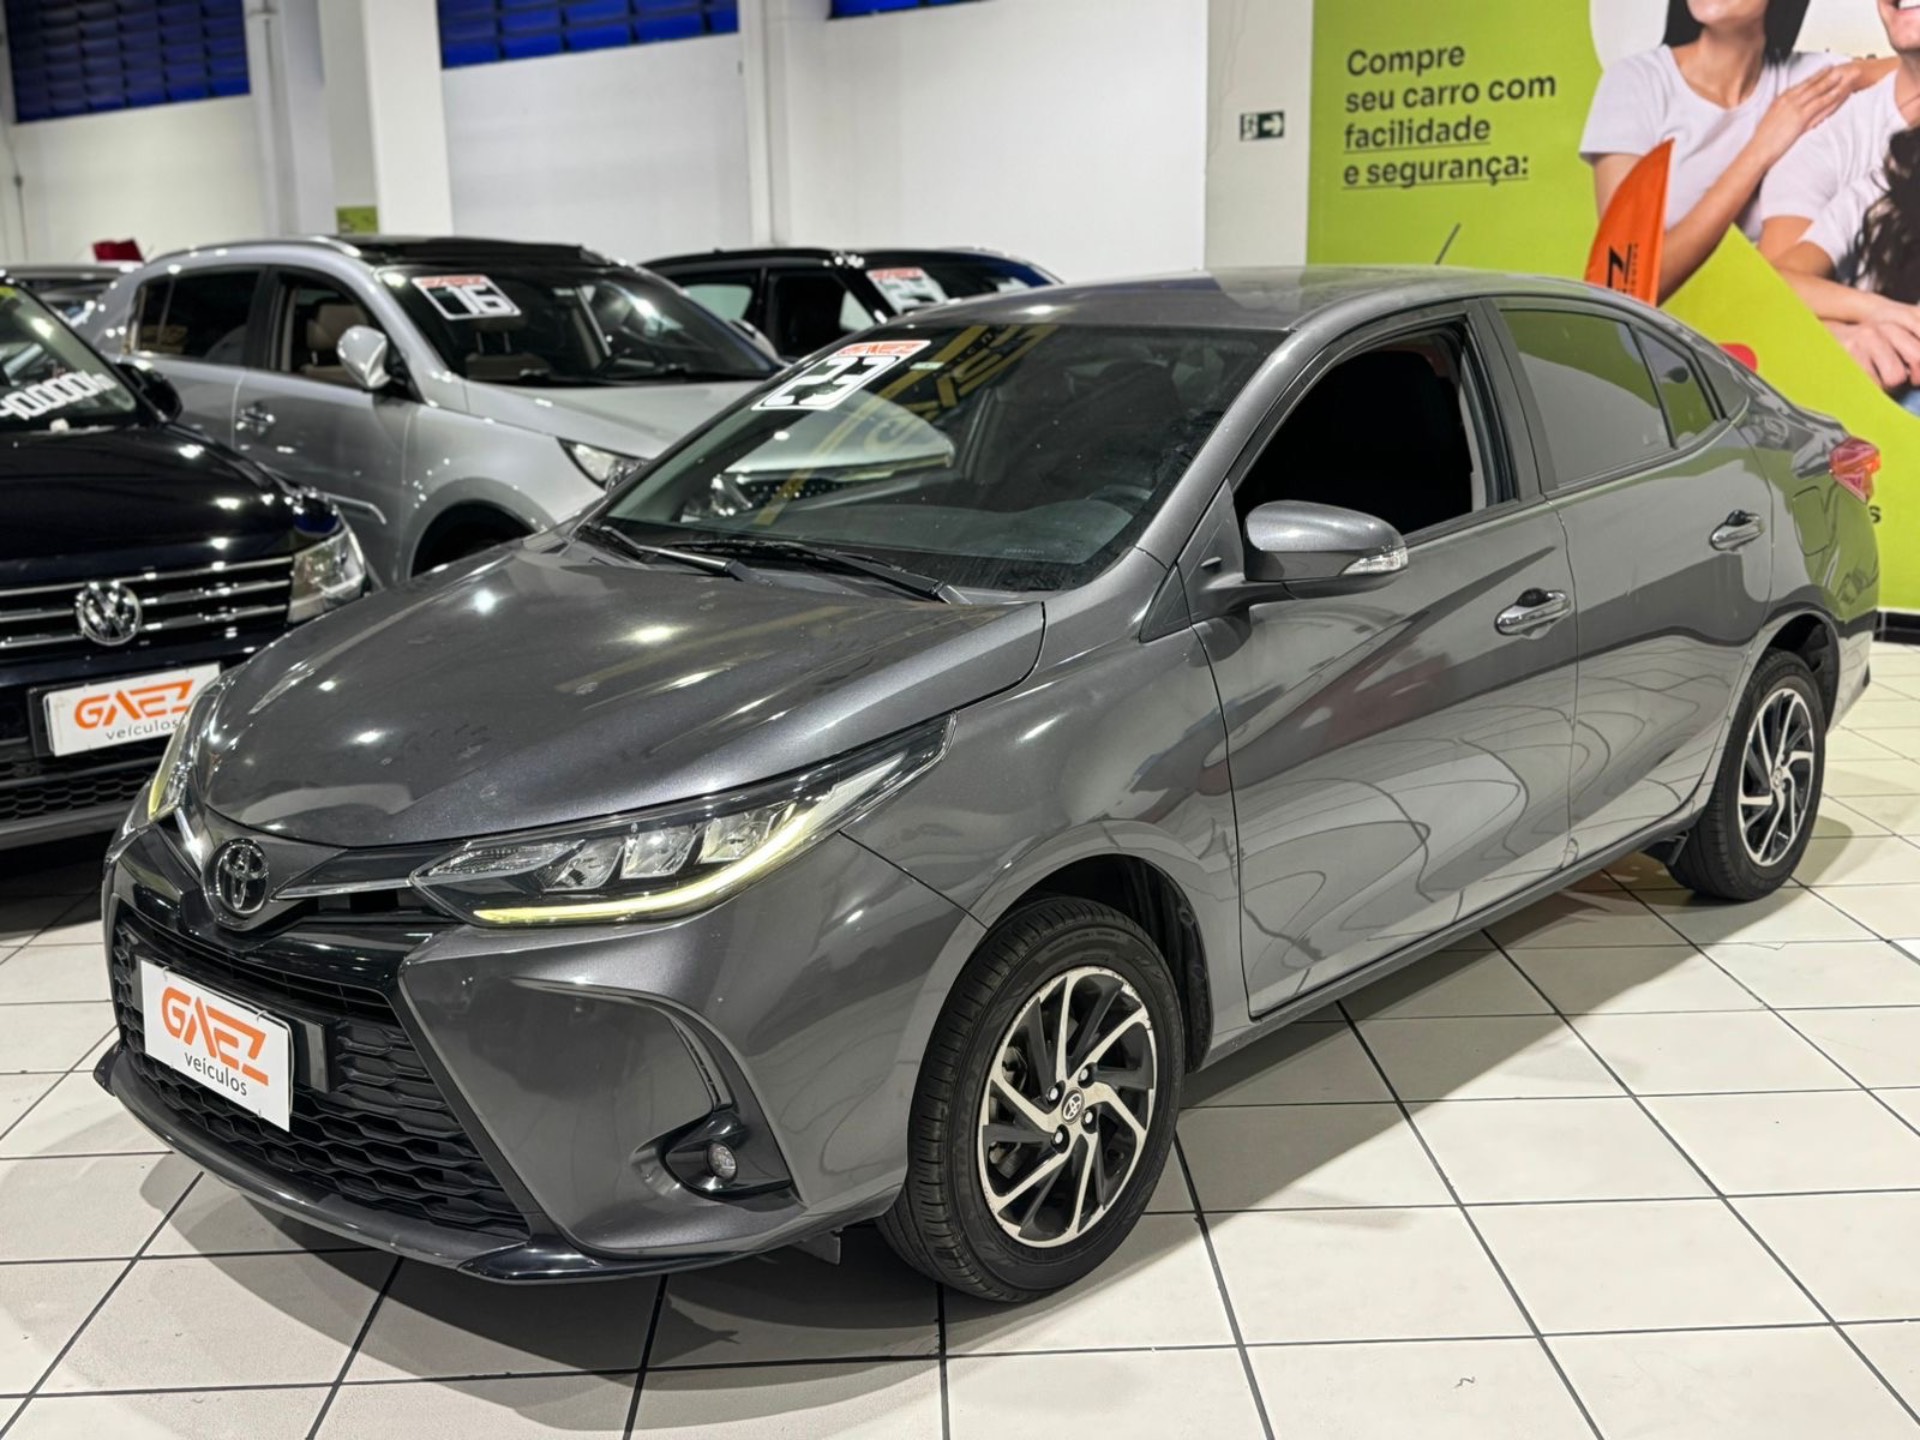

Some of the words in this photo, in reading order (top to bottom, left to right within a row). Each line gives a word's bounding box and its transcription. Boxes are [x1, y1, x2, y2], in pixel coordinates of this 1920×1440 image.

[1347, 45, 1465, 77] Compre
[1345, 90, 1394, 113] seu
[1403, 82, 1480, 108] carro
[1488, 74, 1556, 102] com
[1344, 115, 1491, 149] facilidade
[1344, 164, 1359, 186] e
[1366, 155, 1529, 189] segurança:
[763, 355, 899, 408] 23
[161, 986, 269, 1086] GAEZ
